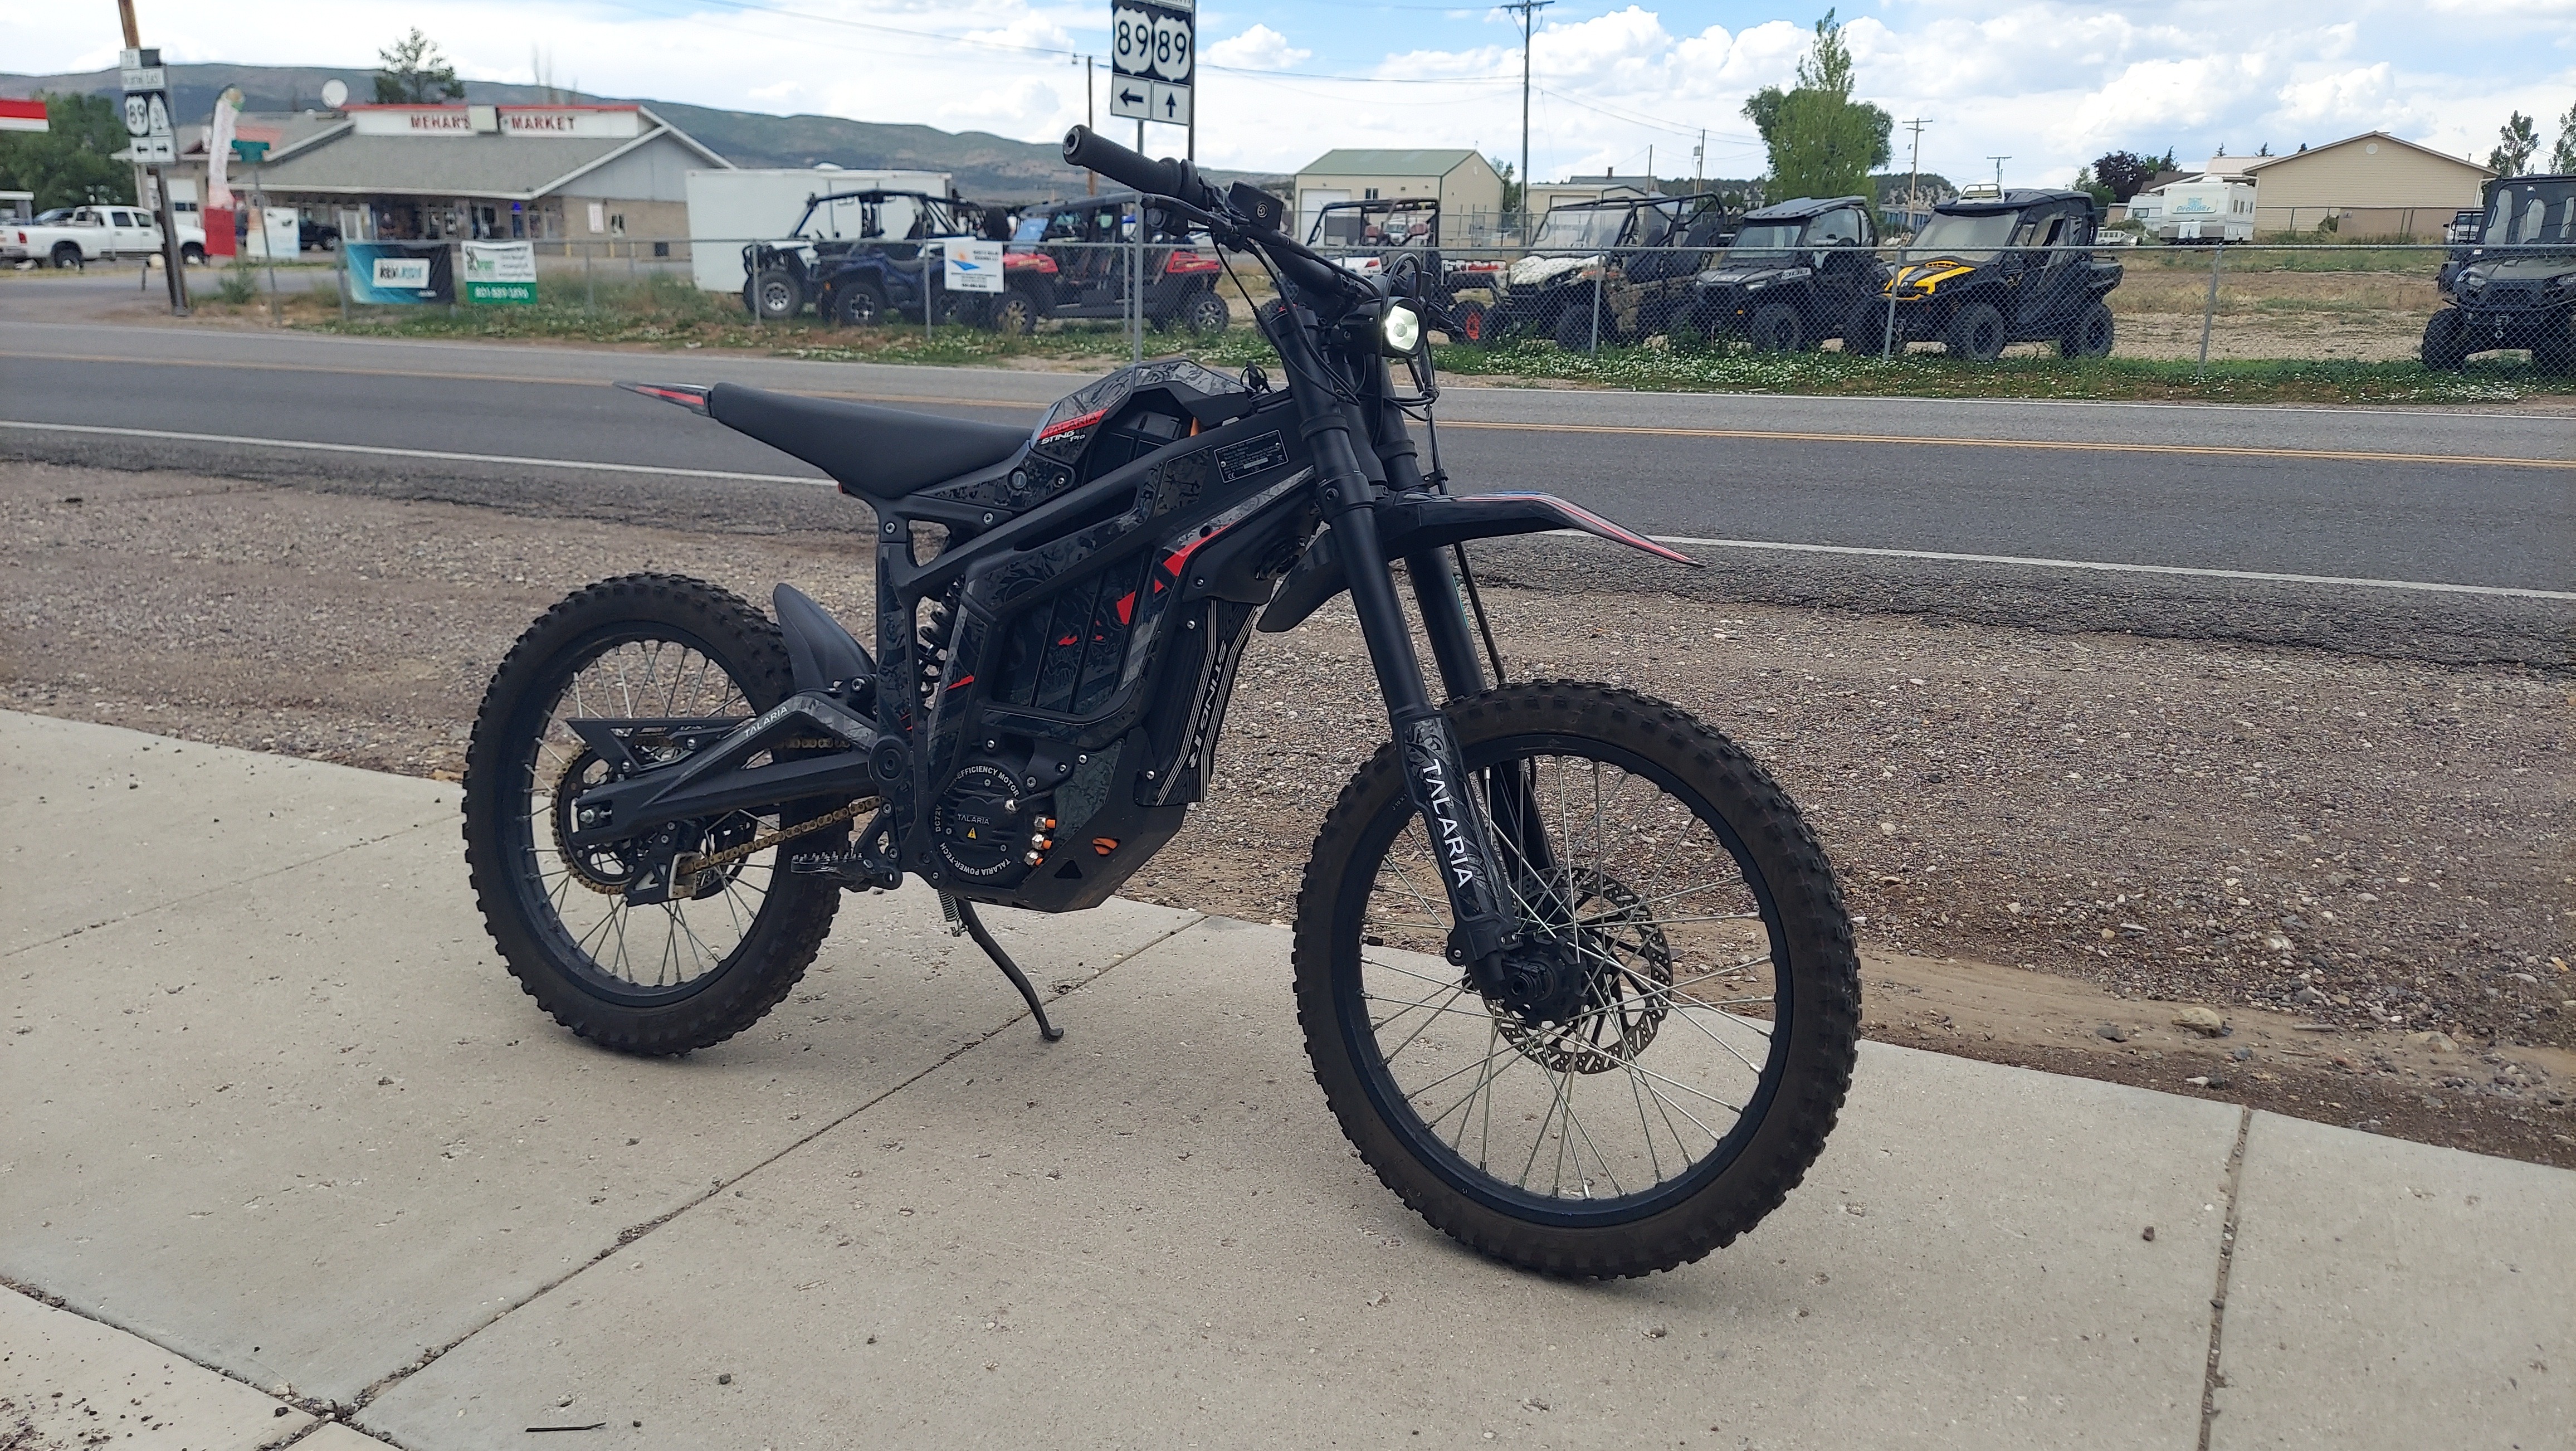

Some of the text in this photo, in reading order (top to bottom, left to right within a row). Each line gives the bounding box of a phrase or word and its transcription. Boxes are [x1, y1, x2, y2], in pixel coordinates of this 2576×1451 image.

[1118, 20, 1148, 57] 89
[1158, 30, 1187, 64] 89
[129, 104, 145, 125] 89
[512, 116, 574, 130] MARKET
[1041, 430, 1075, 445] STING
[1046, 414, 1097, 435] TALARIA
[1188, 640, 1226, 768] STING R
[744, 706, 788, 737] TALARIA
[998, 771, 1019, 797] MOTOR
[934, 804, 943, 832] DC72V
[957, 814, 990, 825] TALARIA
[1423, 758, 1474, 888] TALARIA
[939, 842, 1011, 876] TALARIA POWER-TECH
